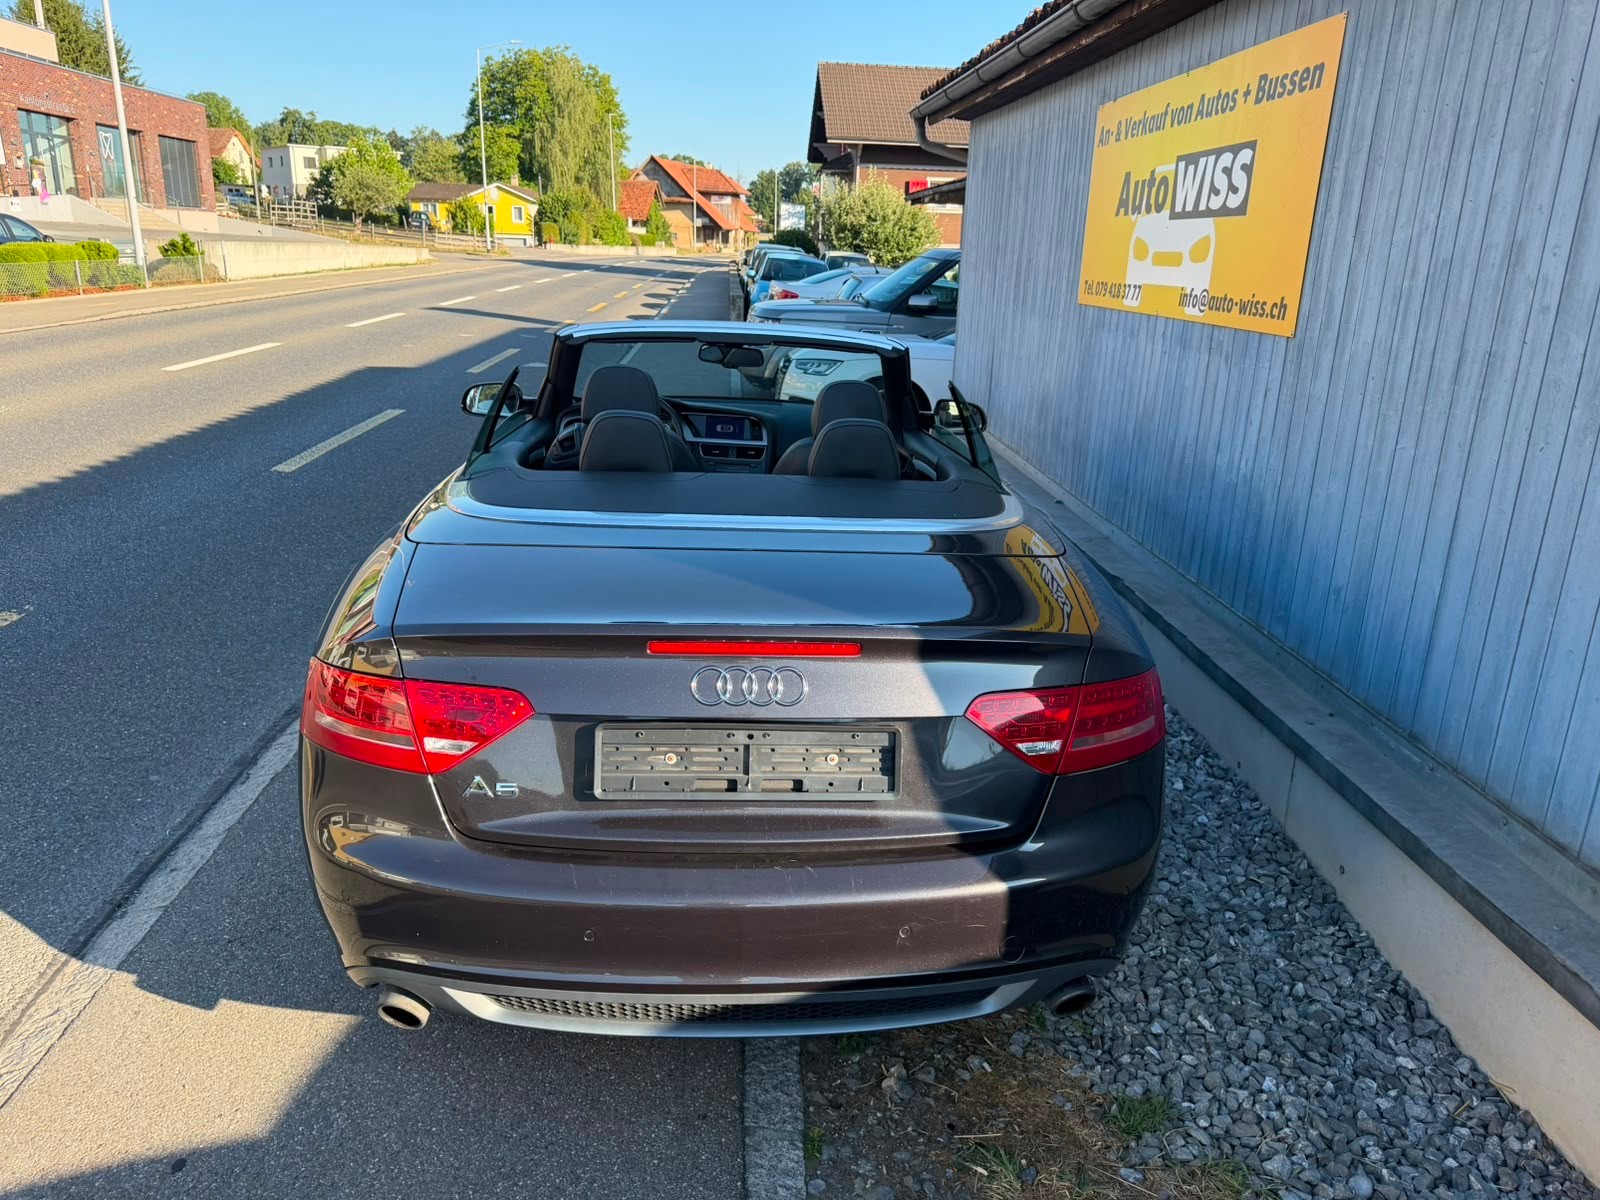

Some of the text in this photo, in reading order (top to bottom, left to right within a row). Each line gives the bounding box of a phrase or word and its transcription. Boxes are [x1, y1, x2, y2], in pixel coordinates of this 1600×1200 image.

[1096, 61, 1325, 148] An- & Verkauf von Autos + Bussen
[1114, 148, 1254, 217] Auto WISS
[1084, 279, 1142, 301] Tel. 079 418 37 77
[1178, 287, 1288, 321] info@auto-wiss.ch
[460, 775, 519, 799] A5
